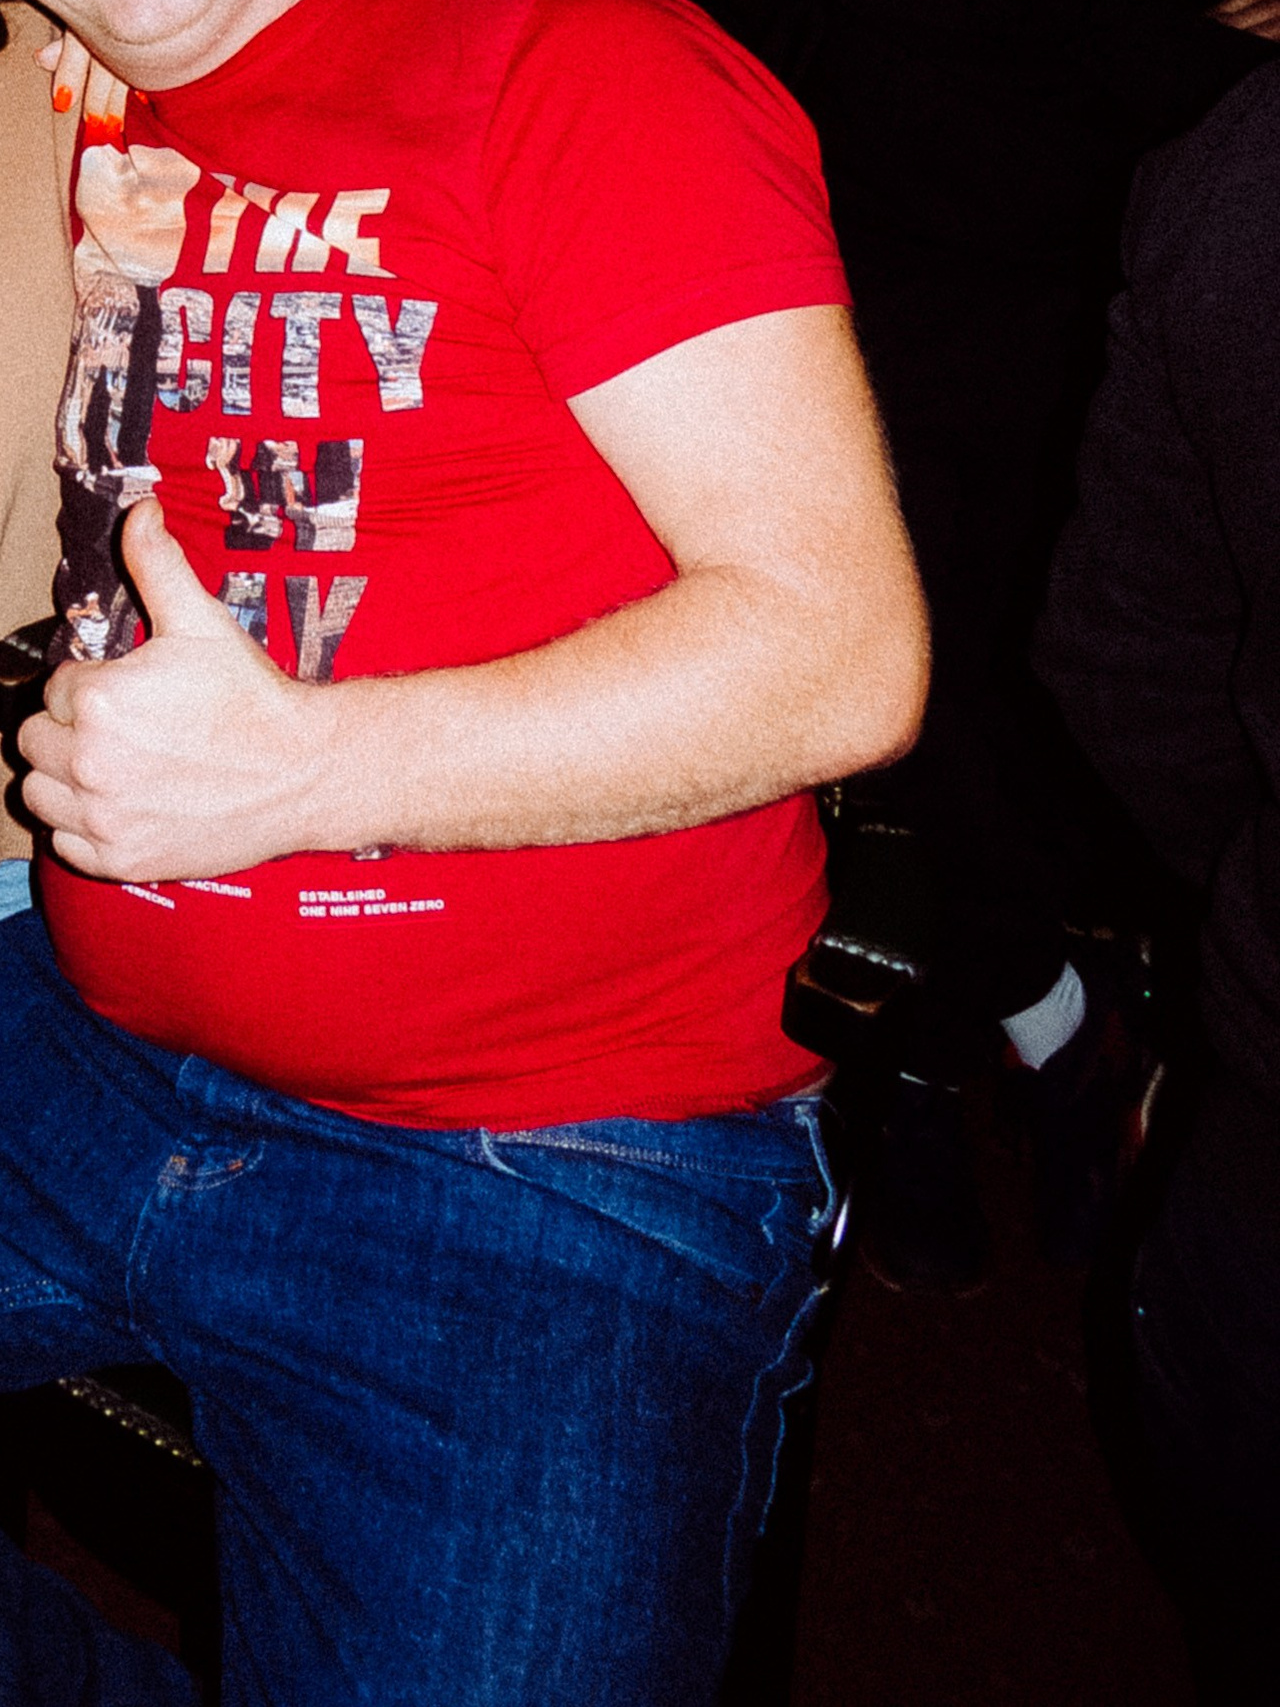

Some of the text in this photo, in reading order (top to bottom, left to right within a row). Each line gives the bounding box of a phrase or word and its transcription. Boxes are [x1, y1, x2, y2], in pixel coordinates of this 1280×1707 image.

[202, 172, 398, 279] THE
[158, 287, 439, 418] CITY
[299, 899, 445, 918] ONE NINE SEVEN ZERO
